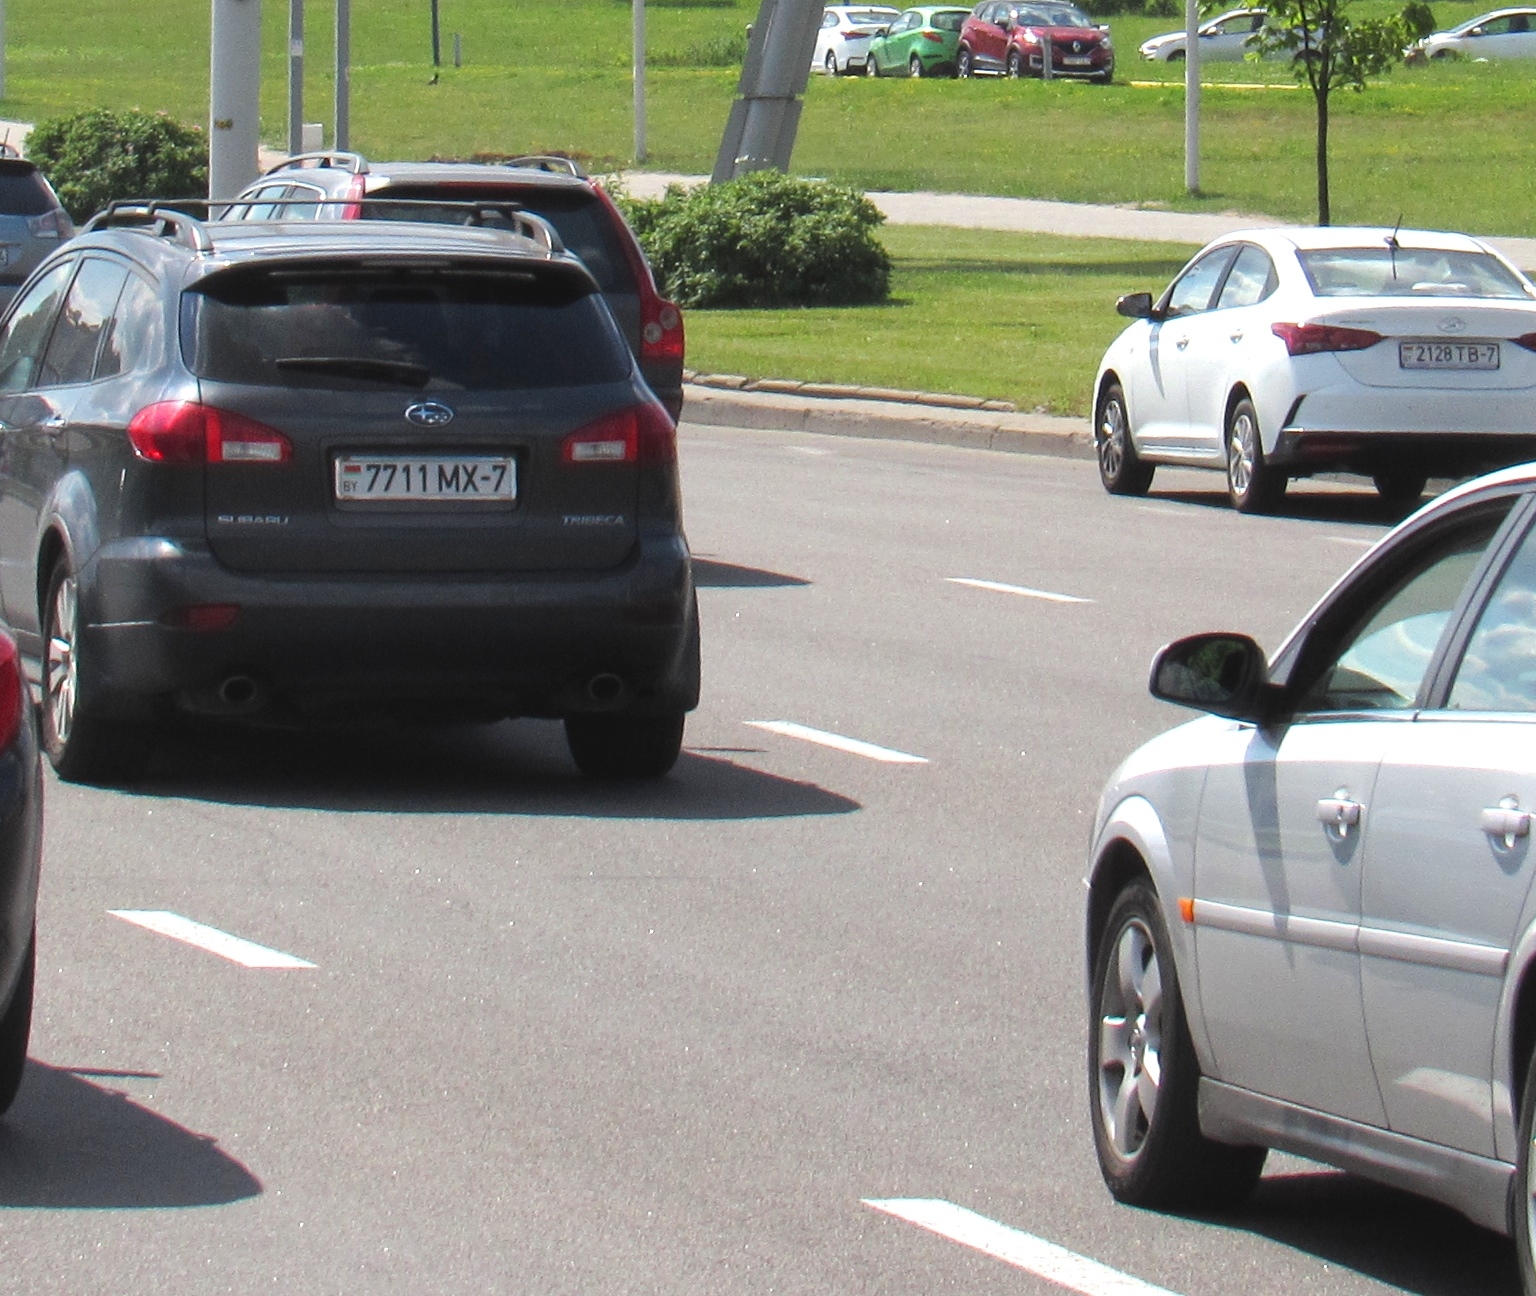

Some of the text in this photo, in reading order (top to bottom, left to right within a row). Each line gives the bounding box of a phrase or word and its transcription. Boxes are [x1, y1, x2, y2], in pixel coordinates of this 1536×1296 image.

[1416, 346, 1497, 363] 2128 TB-7
[366, 462, 430, 494] 7711
[437, 463, 508, 494] MX-7
